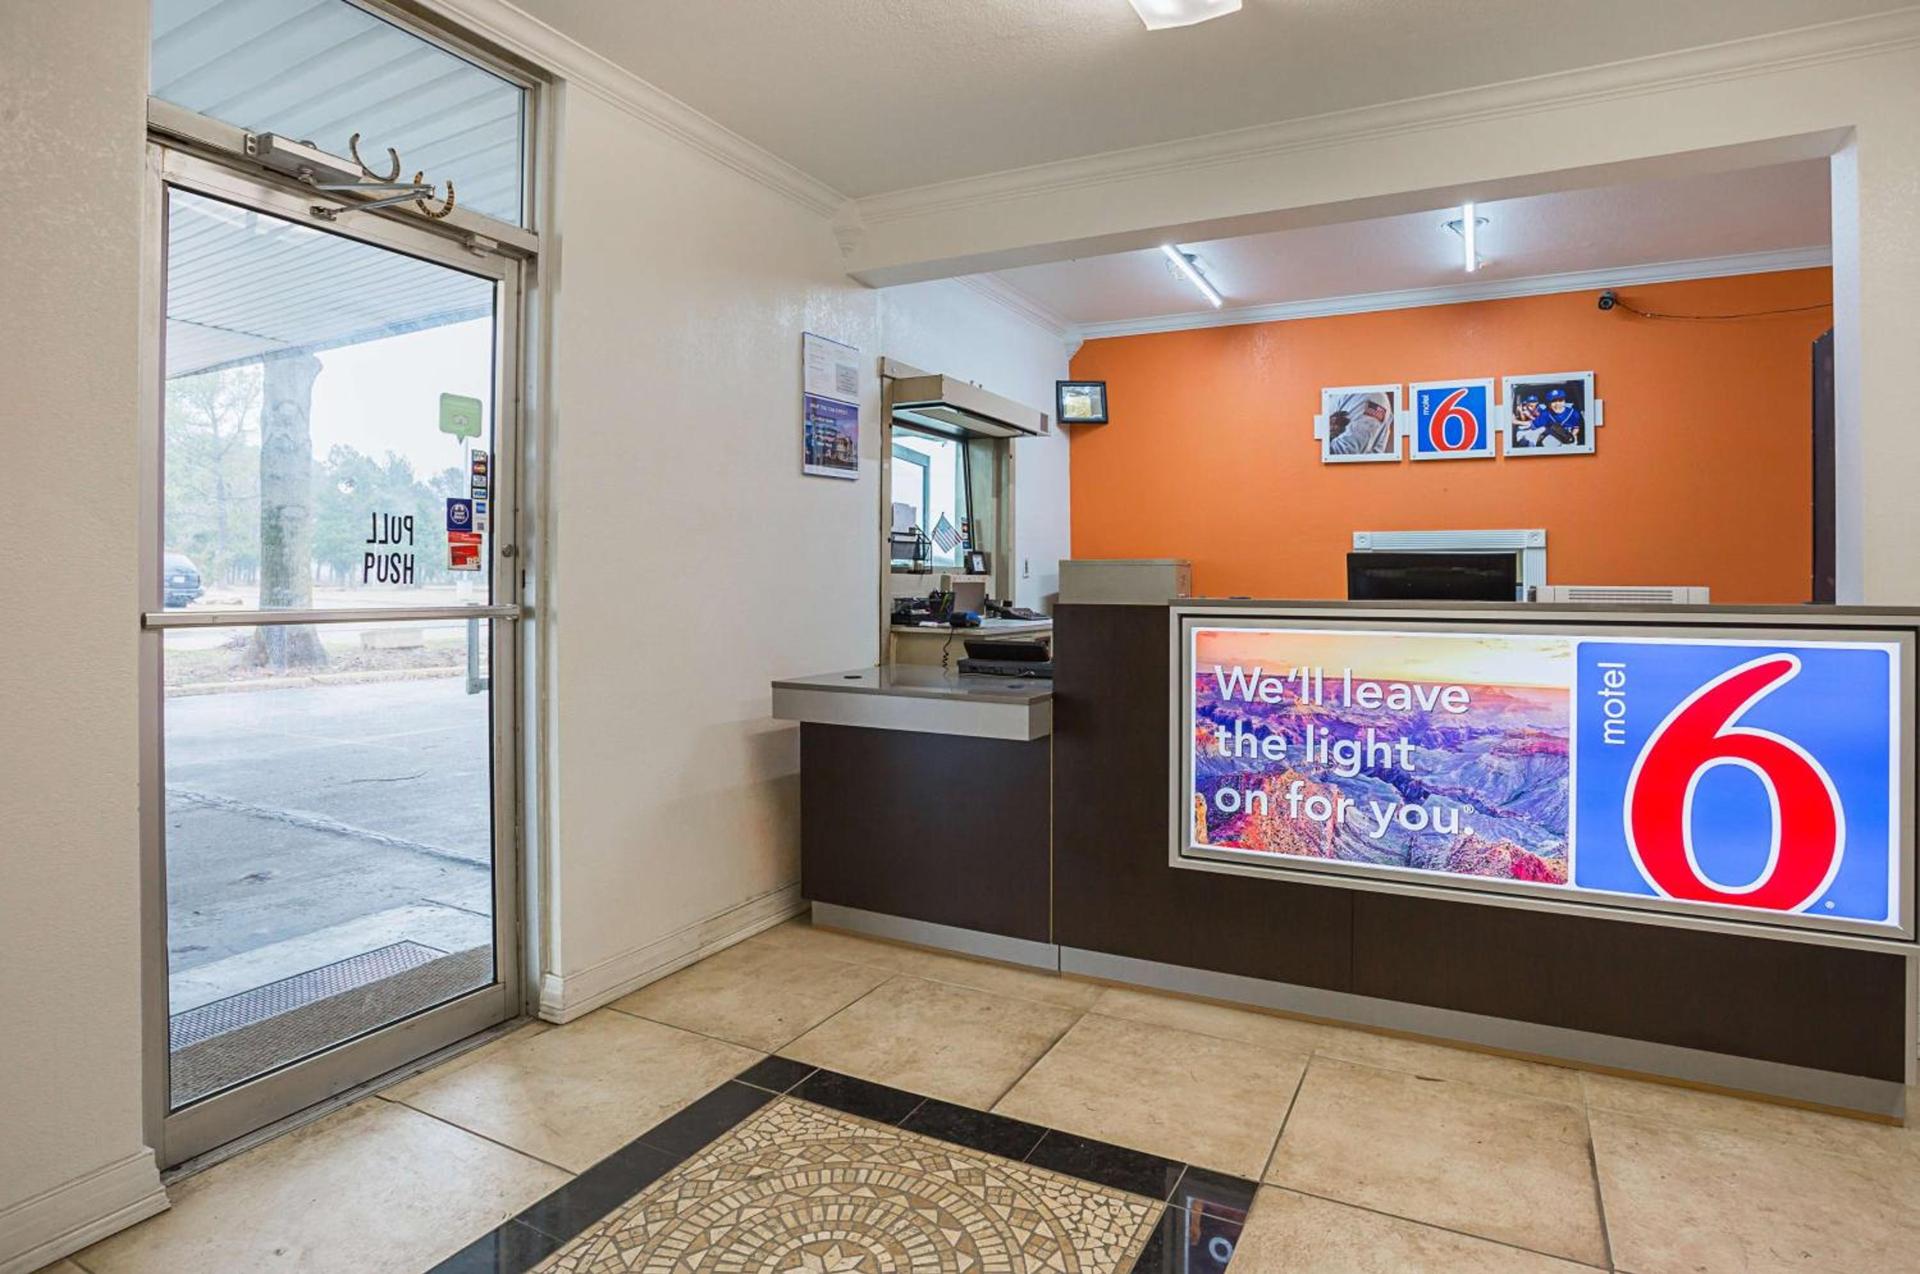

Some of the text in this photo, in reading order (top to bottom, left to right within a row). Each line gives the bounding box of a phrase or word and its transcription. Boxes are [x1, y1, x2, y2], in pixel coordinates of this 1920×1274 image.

[1428, 388, 1479, 452] 6
[363, 552, 415, 584] PUSH
[1214, 664, 1472, 715] We'll leave
[1215, 720, 1416, 778] the light
[1214, 786, 1269, 817] on
[1286, 780, 1356, 824] for
[1597, 652, 1846, 914] motel 6
